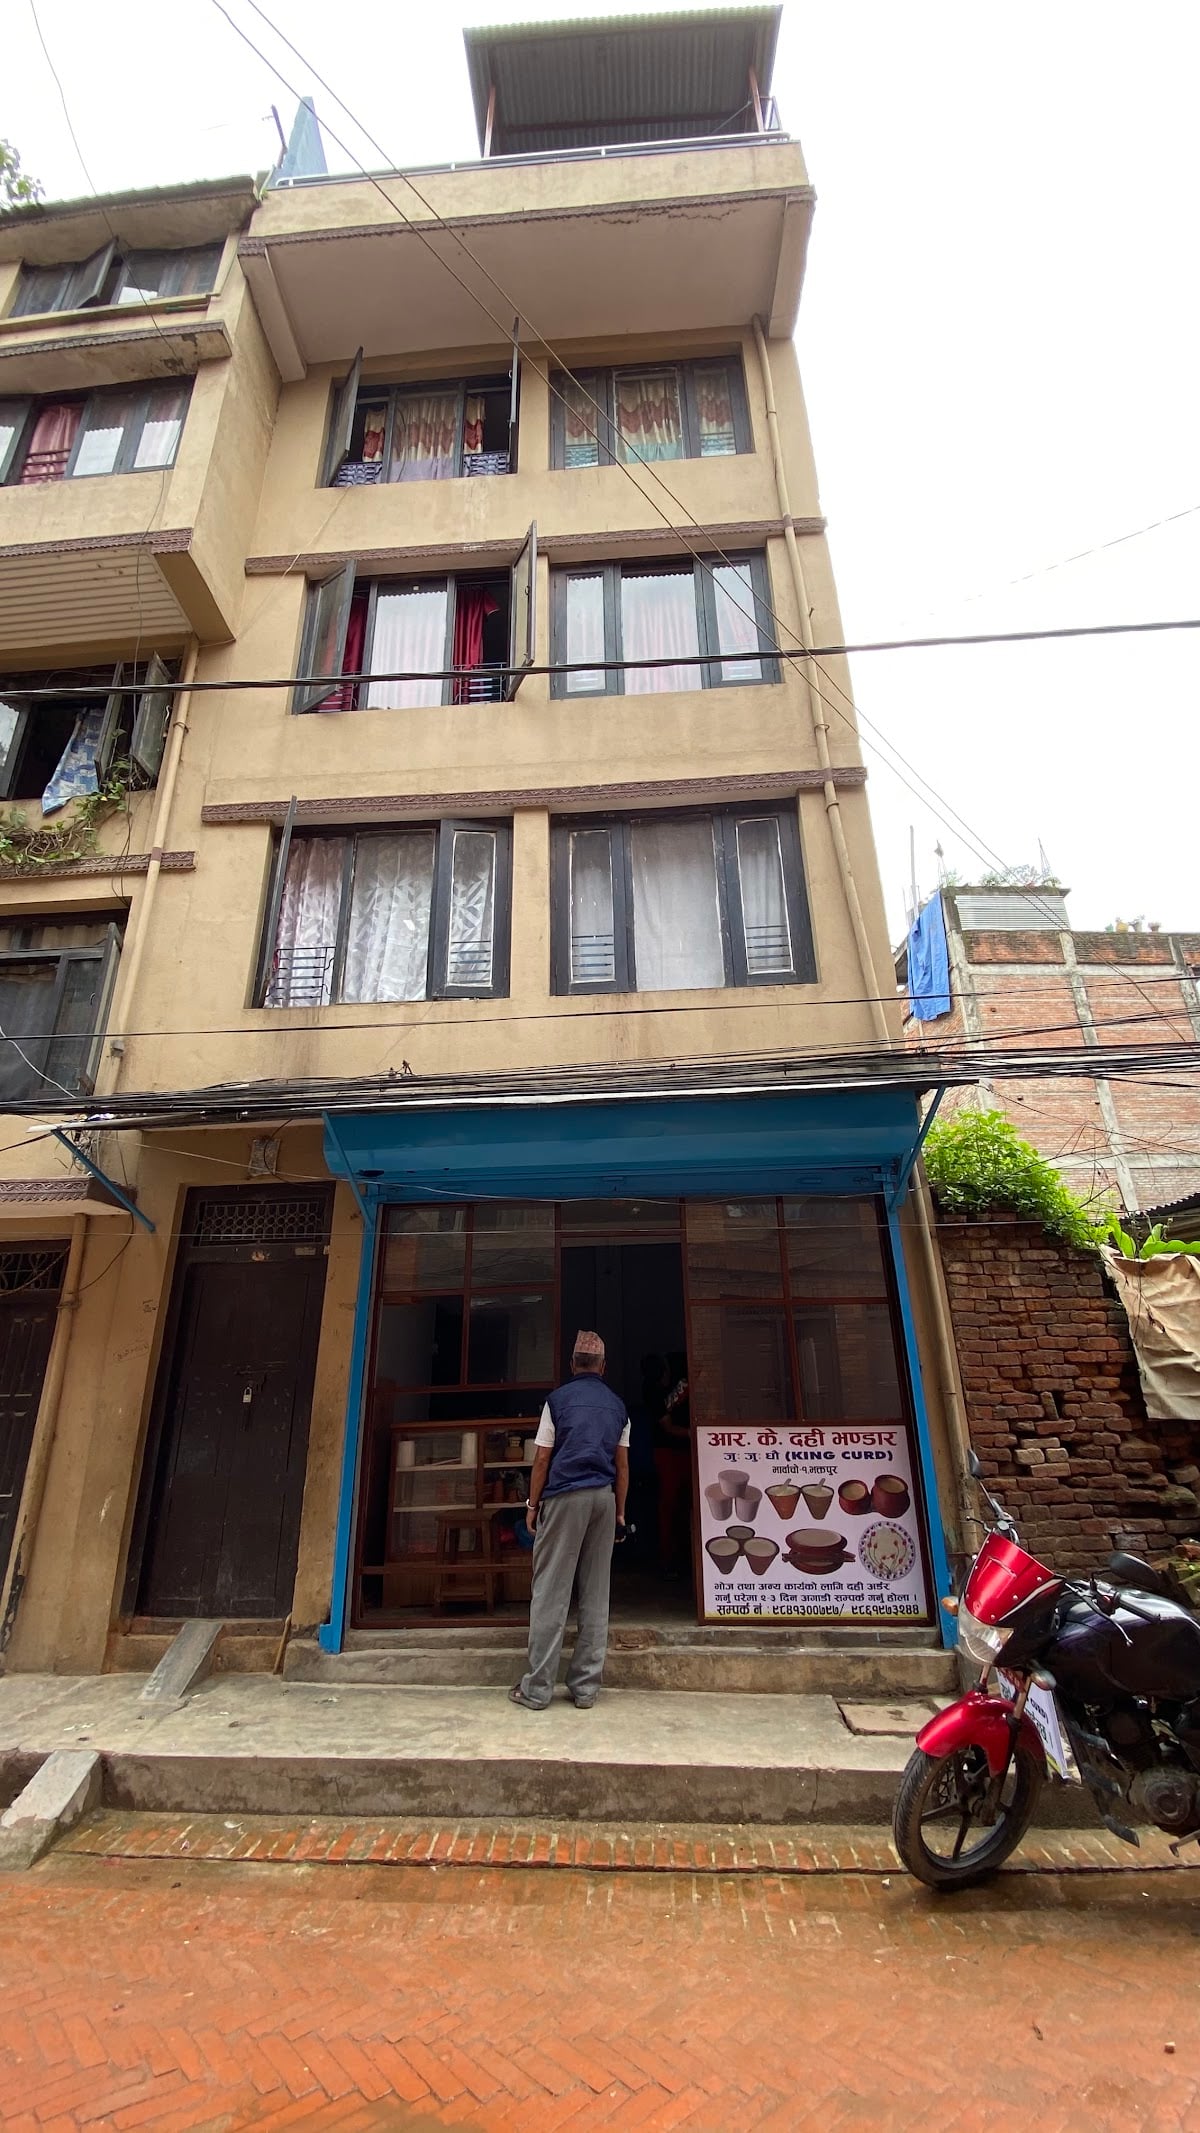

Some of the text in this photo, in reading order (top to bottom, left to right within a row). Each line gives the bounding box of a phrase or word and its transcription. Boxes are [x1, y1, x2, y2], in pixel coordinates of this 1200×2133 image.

[788, 1428, 825, 1447] दही
[832, 1432, 897, 1446] भण्डार
[785, 1451, 836, 1461] (KING
[841, 1450, 893, 1461] CURD)
[847, 1582, 864, 1590] दही
